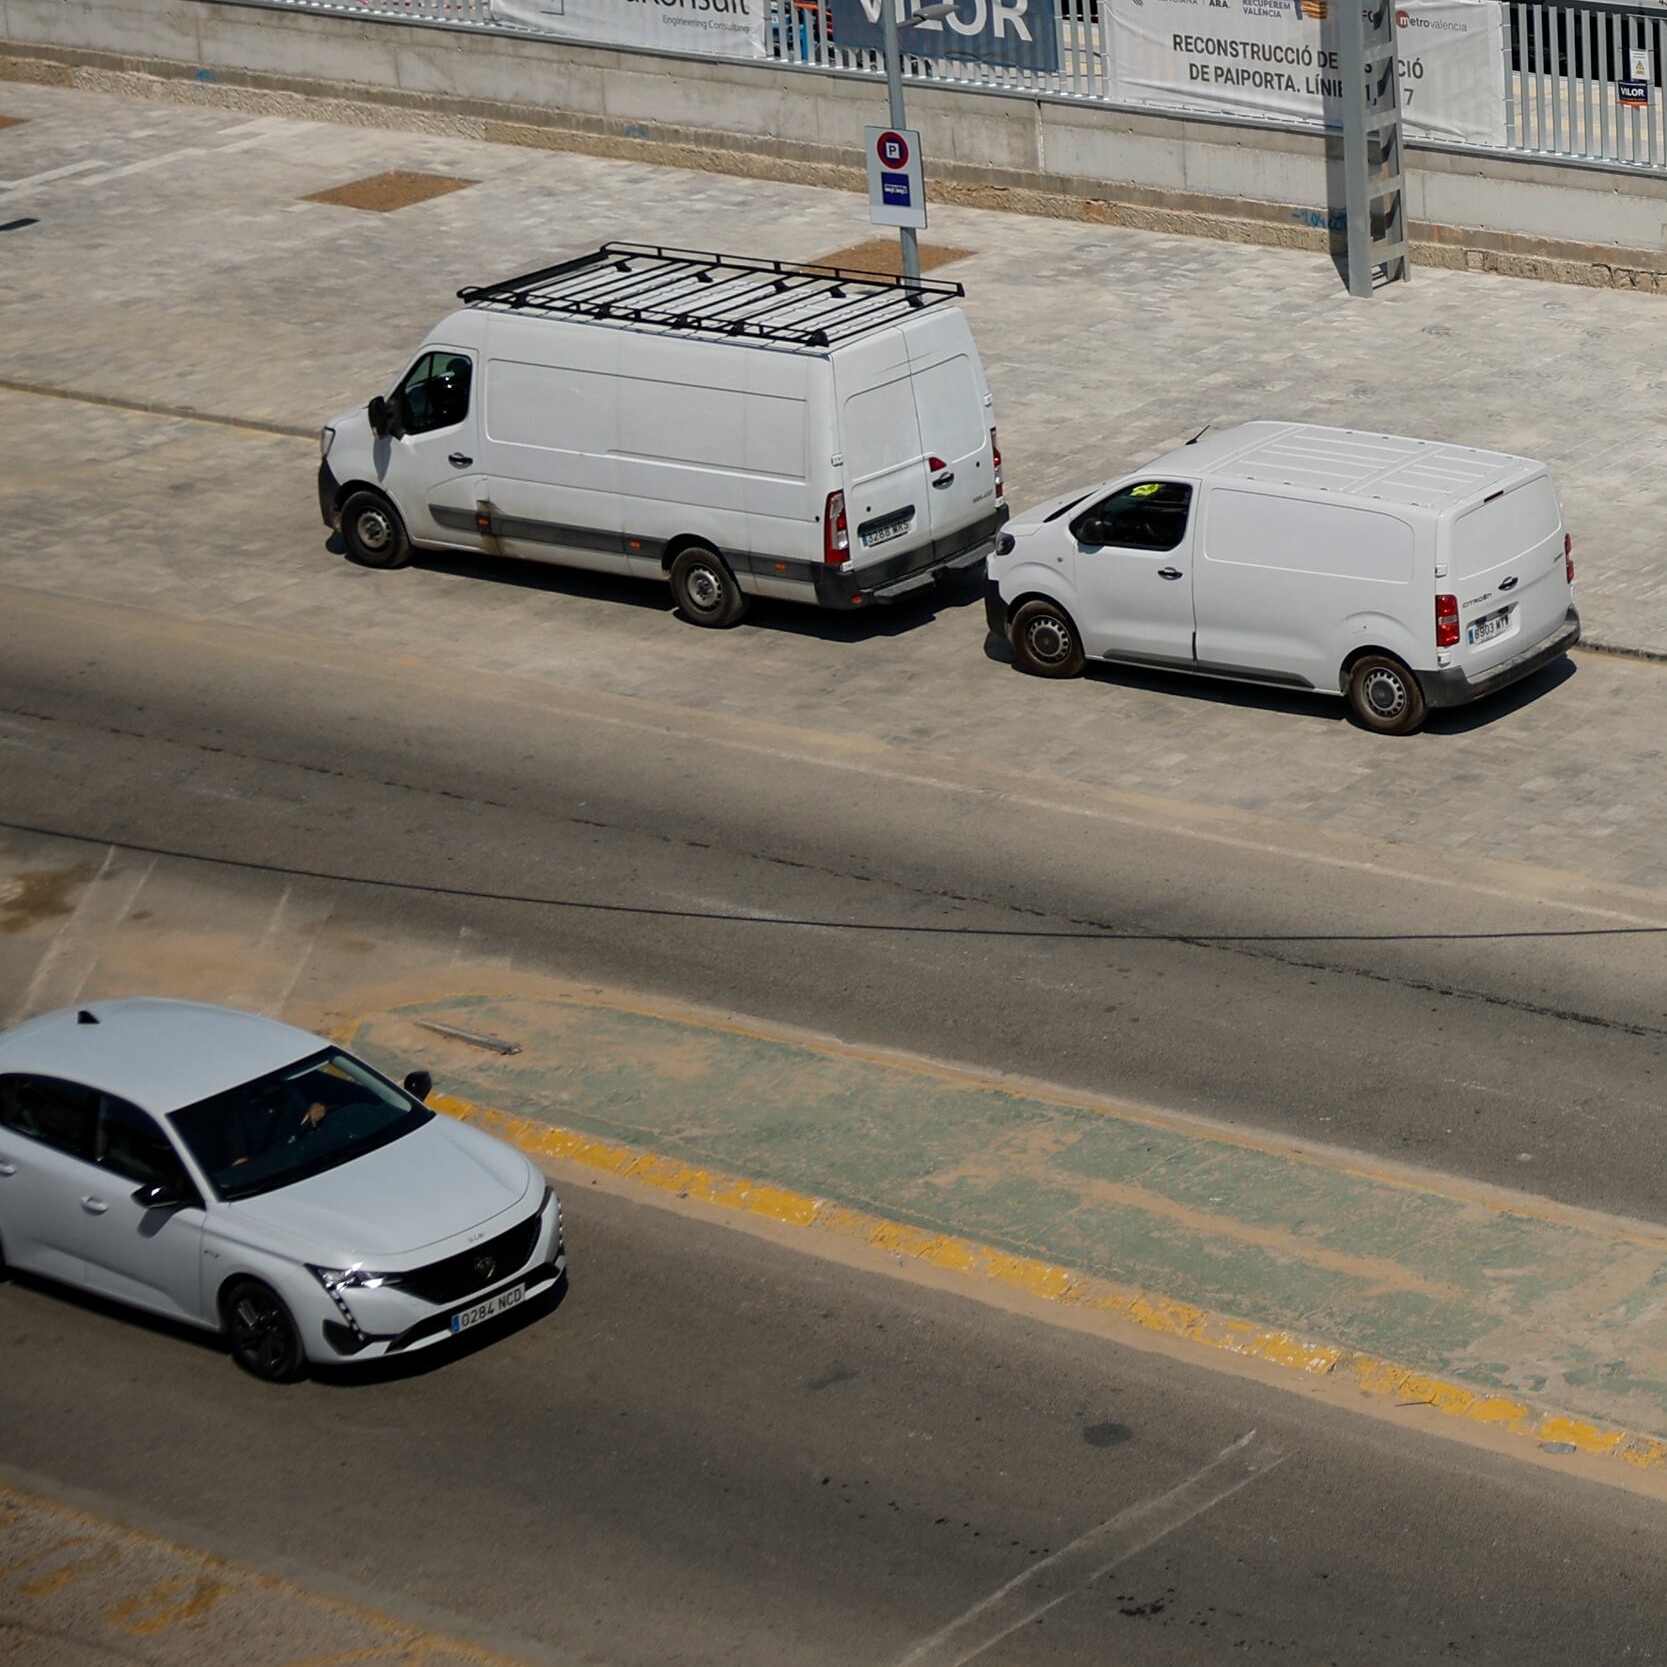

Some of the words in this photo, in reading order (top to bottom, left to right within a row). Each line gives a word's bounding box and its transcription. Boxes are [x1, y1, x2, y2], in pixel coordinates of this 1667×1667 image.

[662, 14, 707, 31] Engineering
[708, 19, 750, 33] Consulting
[1400, 14, 1467, 32] metrovalencia
[1173, 34, 1312, 66] RECONSTRUCCIÓ
[1318, 51, 1338, 69] DE
[1189, 63, 1210, 82] DE
[1214, 66, 1300, 93] PAIPORTA.
[1404, 88, 1414, 105] 7
[1621, 86, 1645, 97] VILOR
[888, 145, 896, 155] P
[462, 1301, 494, 1327] 0284
[498, 1288, 521, 1311] NCD
